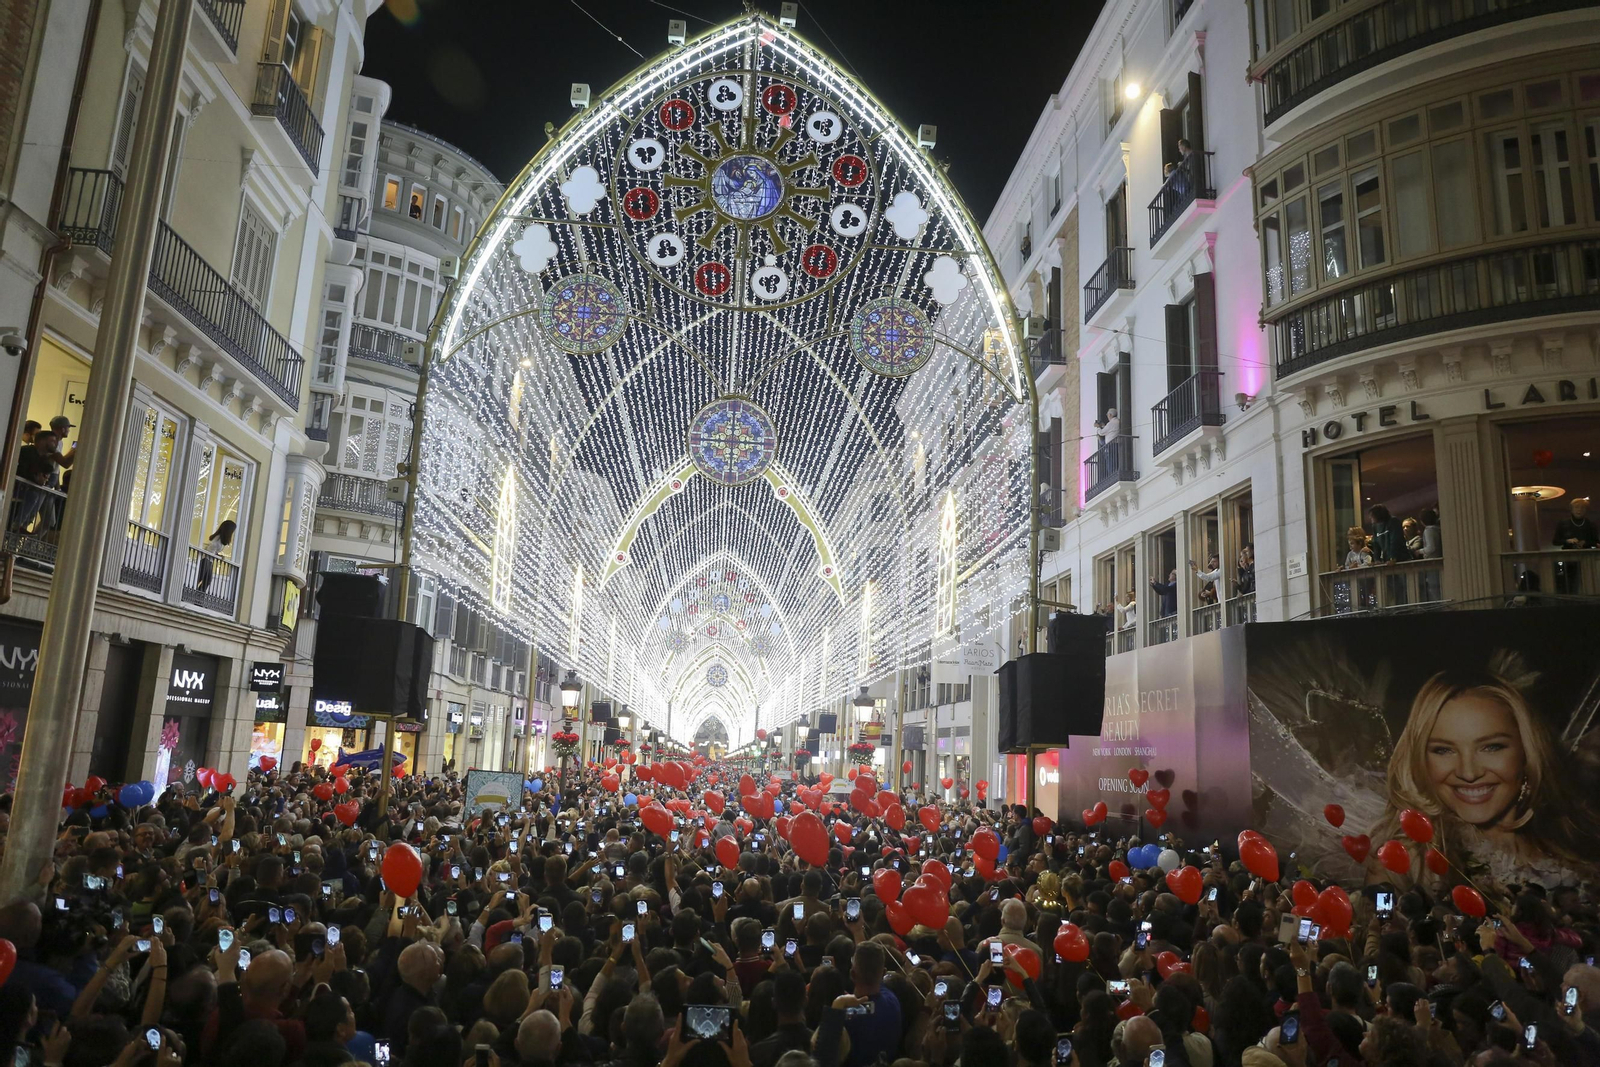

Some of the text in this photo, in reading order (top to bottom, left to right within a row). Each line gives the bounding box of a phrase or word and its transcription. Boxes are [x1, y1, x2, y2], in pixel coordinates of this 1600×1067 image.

[1302, 377, 1599, 448] HOTEL LARI
[963, 648, 994, 658] LARIOS
[173, 668, 205, 690] NYX
[253, 668, 281, 678] NYX
[1134, 687, 1180, 714] SECRET
[1103, 720, 1140, 742] BEAUTY
[1113, 747, 1132, 756] LONDON
[1134, 746, 1157, 756] SHANGHAI
[1098, 777, 1128, 793] OPENING
